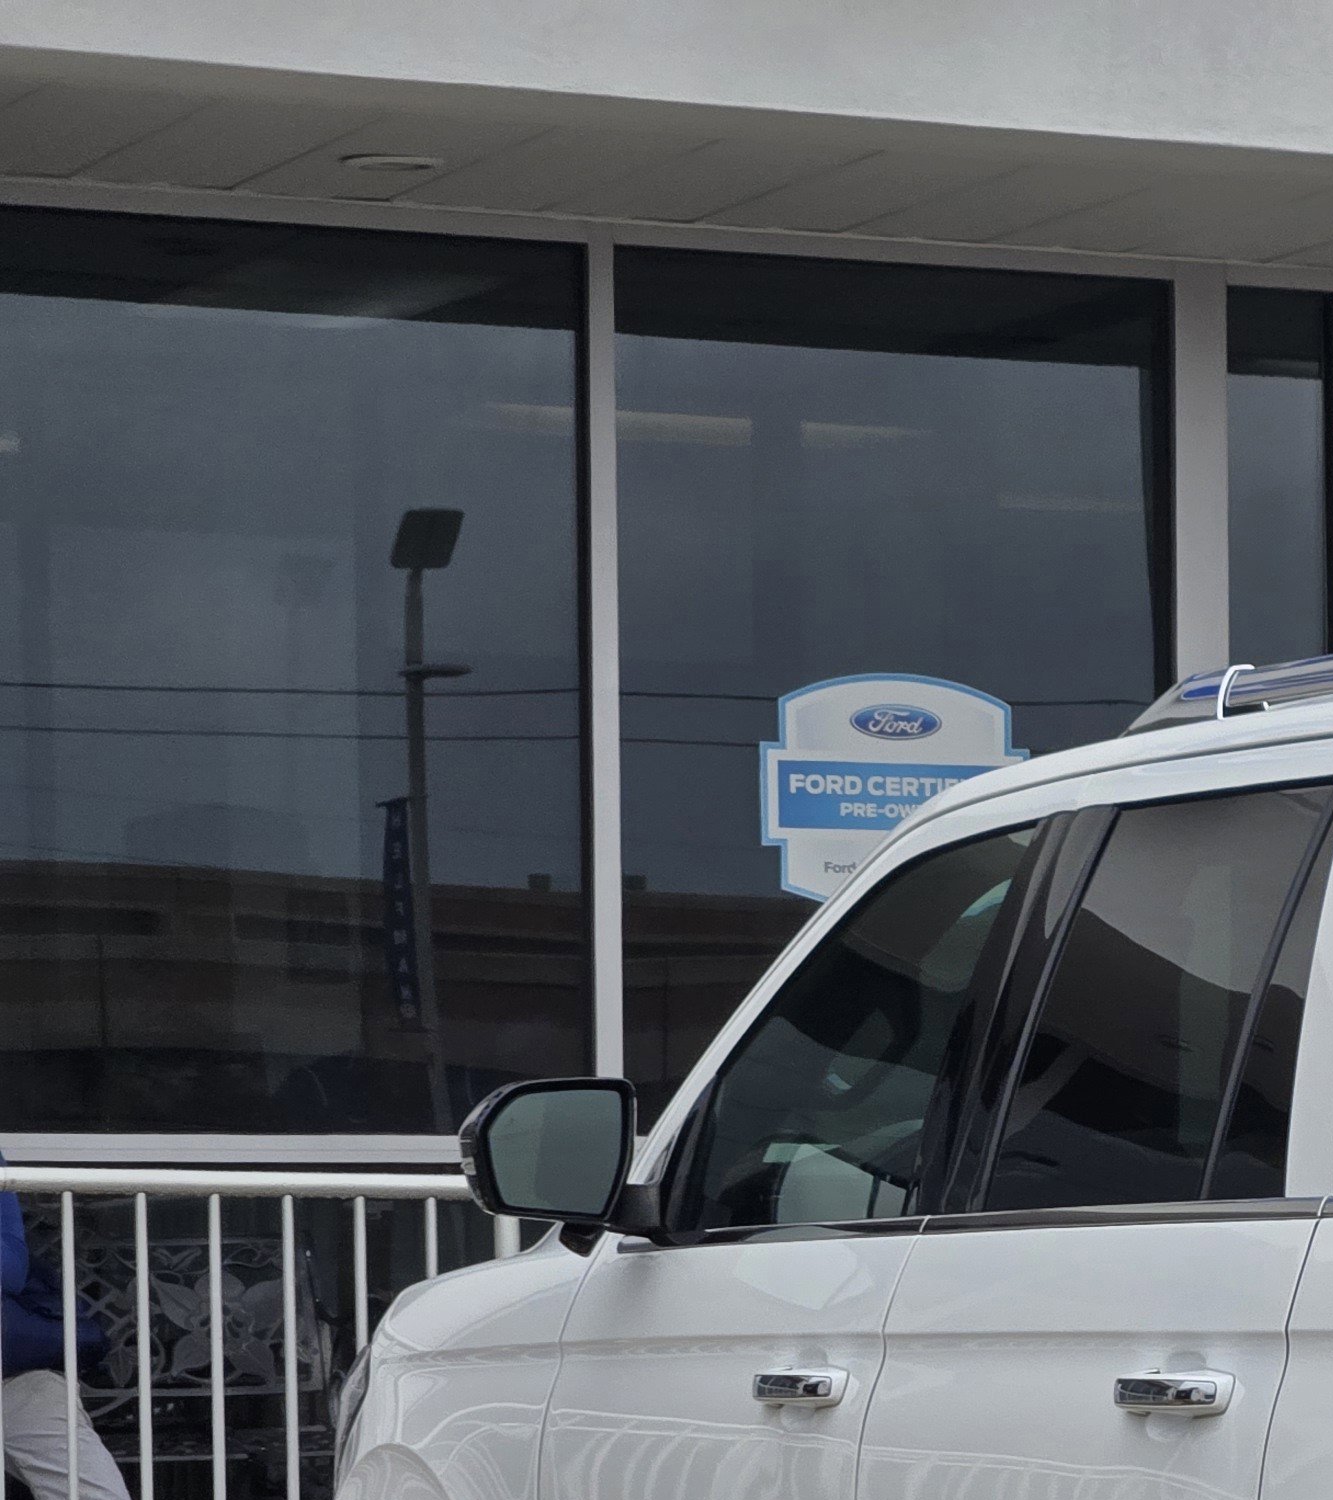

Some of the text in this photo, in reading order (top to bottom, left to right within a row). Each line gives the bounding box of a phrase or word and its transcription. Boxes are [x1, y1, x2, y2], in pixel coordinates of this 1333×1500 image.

[868, 709, 924, 735] Ford
[789, 773, 970, 797] FORD CERTIF
[840, 802, 921, 818] PRE-OW
